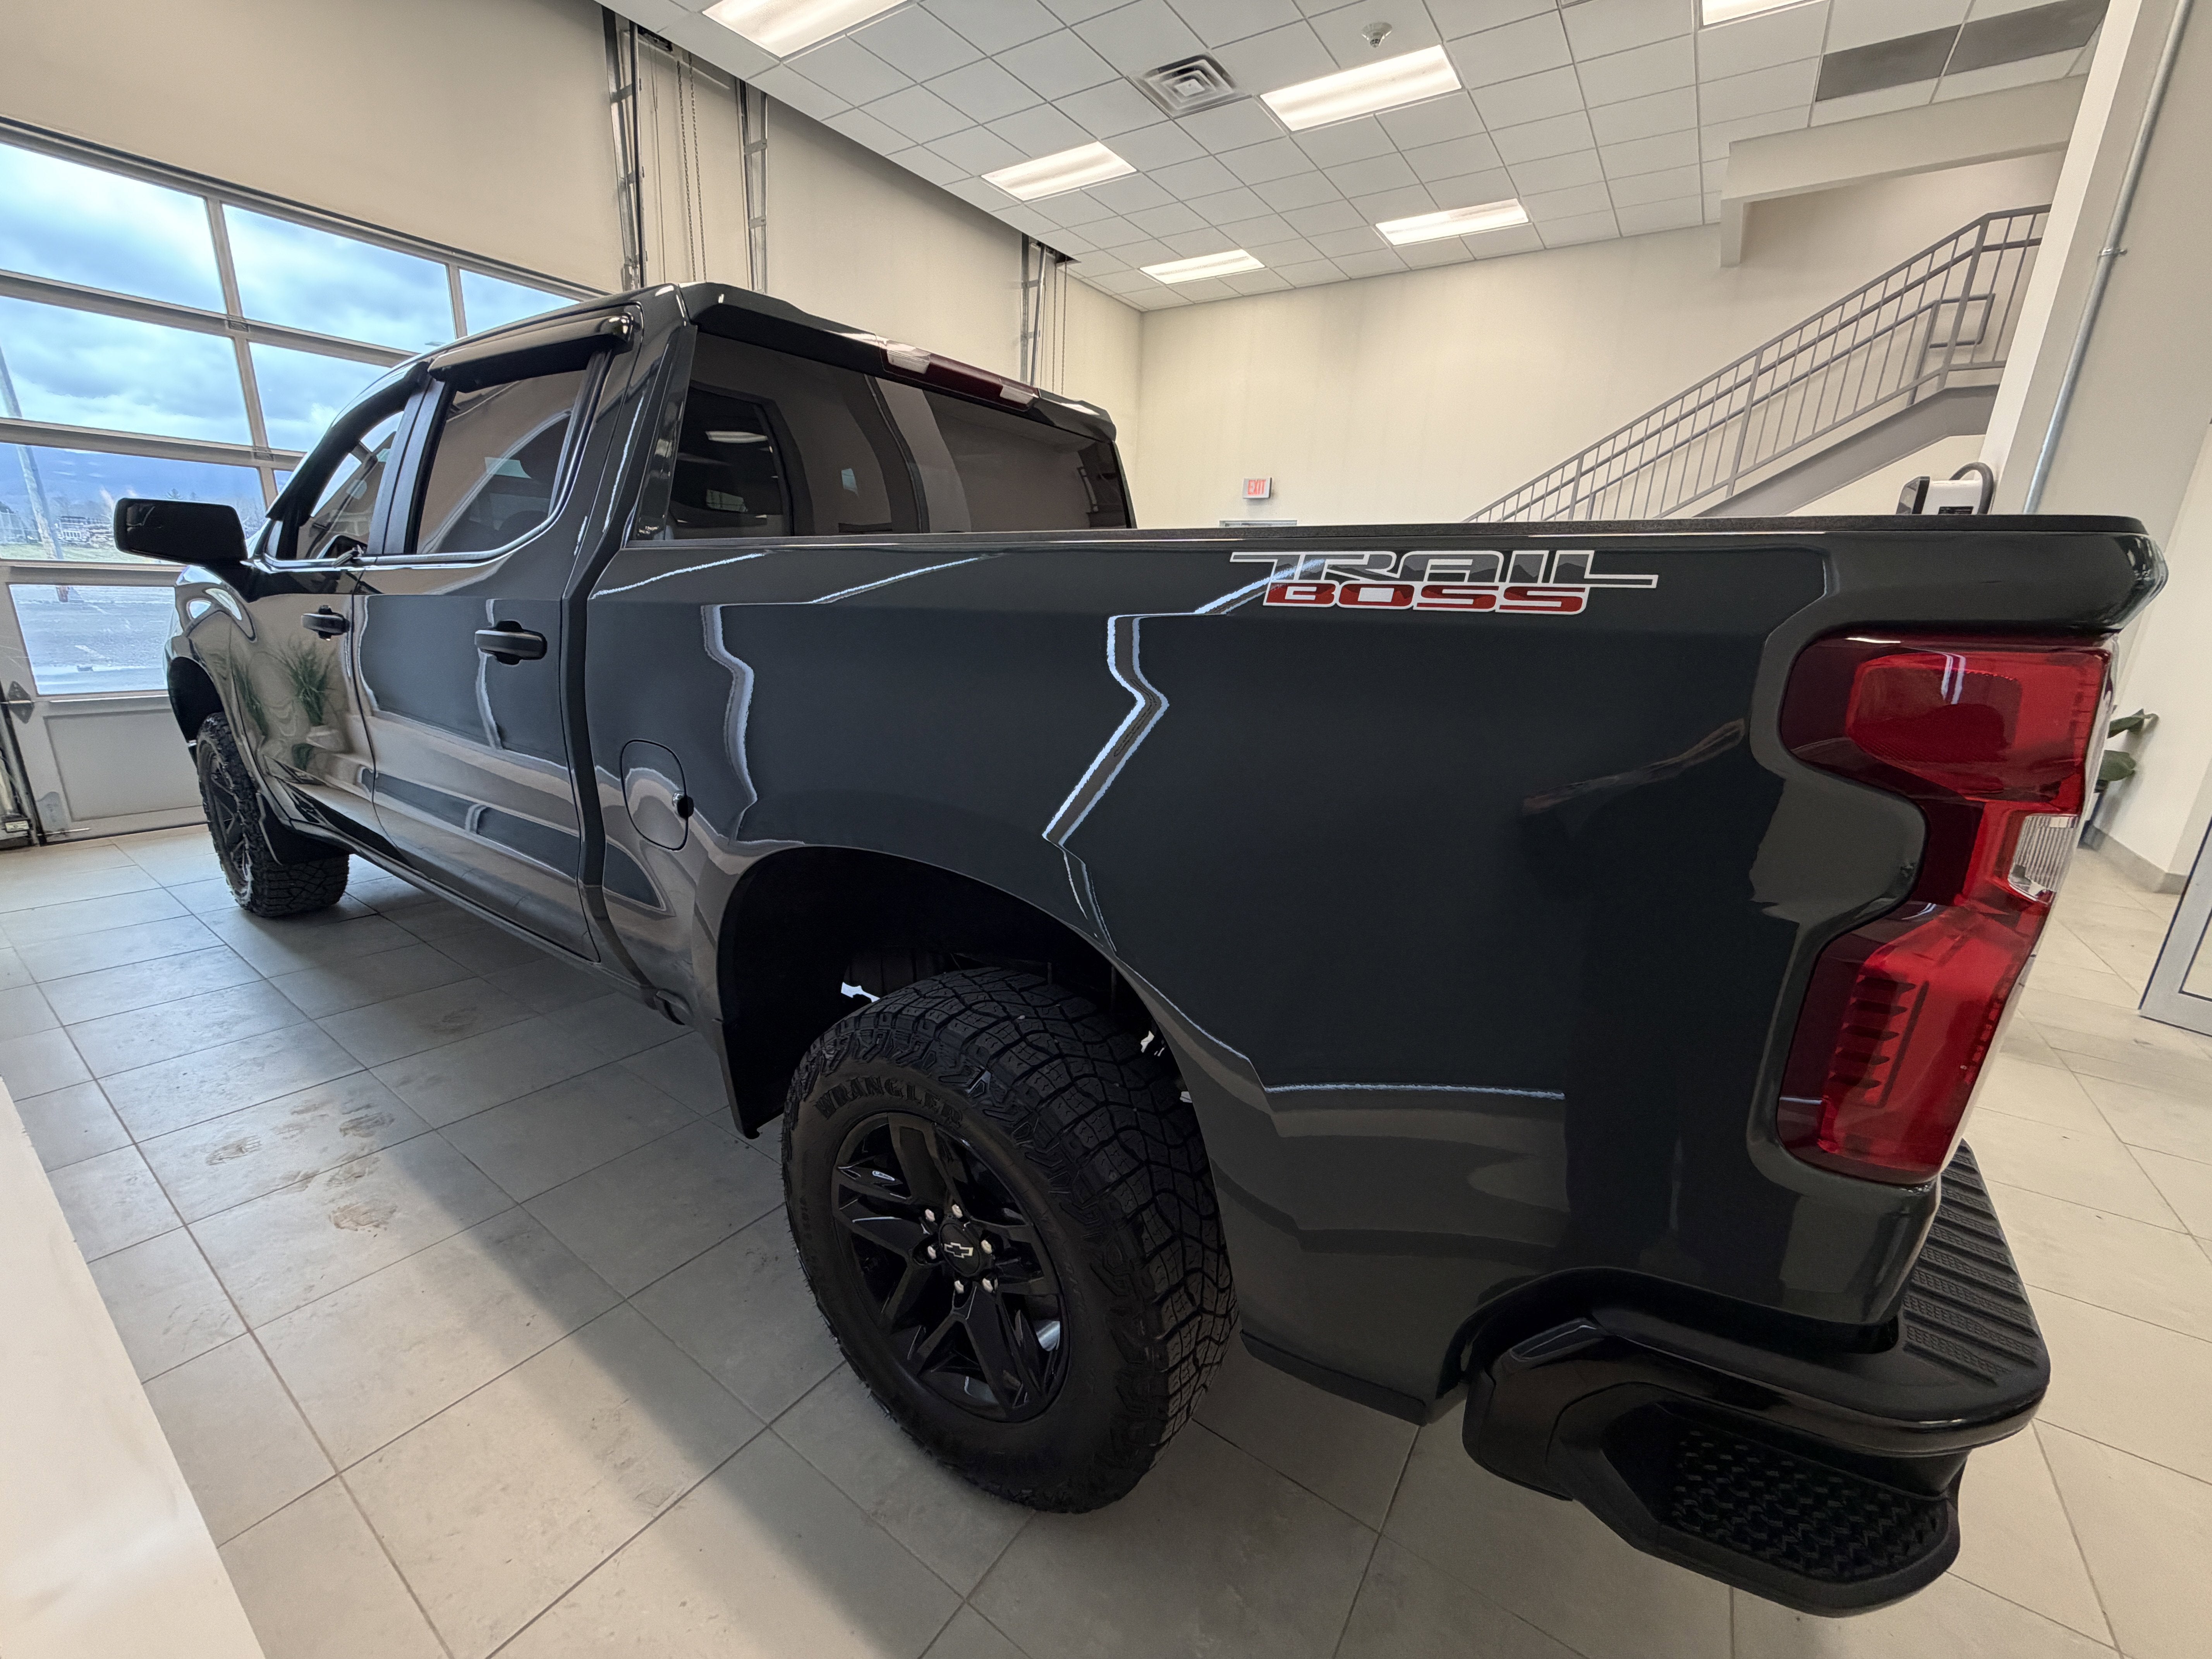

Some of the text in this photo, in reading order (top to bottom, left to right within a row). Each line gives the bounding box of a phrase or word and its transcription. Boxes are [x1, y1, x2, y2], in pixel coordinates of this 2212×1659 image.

[1248, 479, 1266, 495] EXIT
[1230, 550, 1658, 588] TRAIL
[1263, 581, 1590, 615] BOSS
[815, 1076, 963, 1127] WRANGLER
